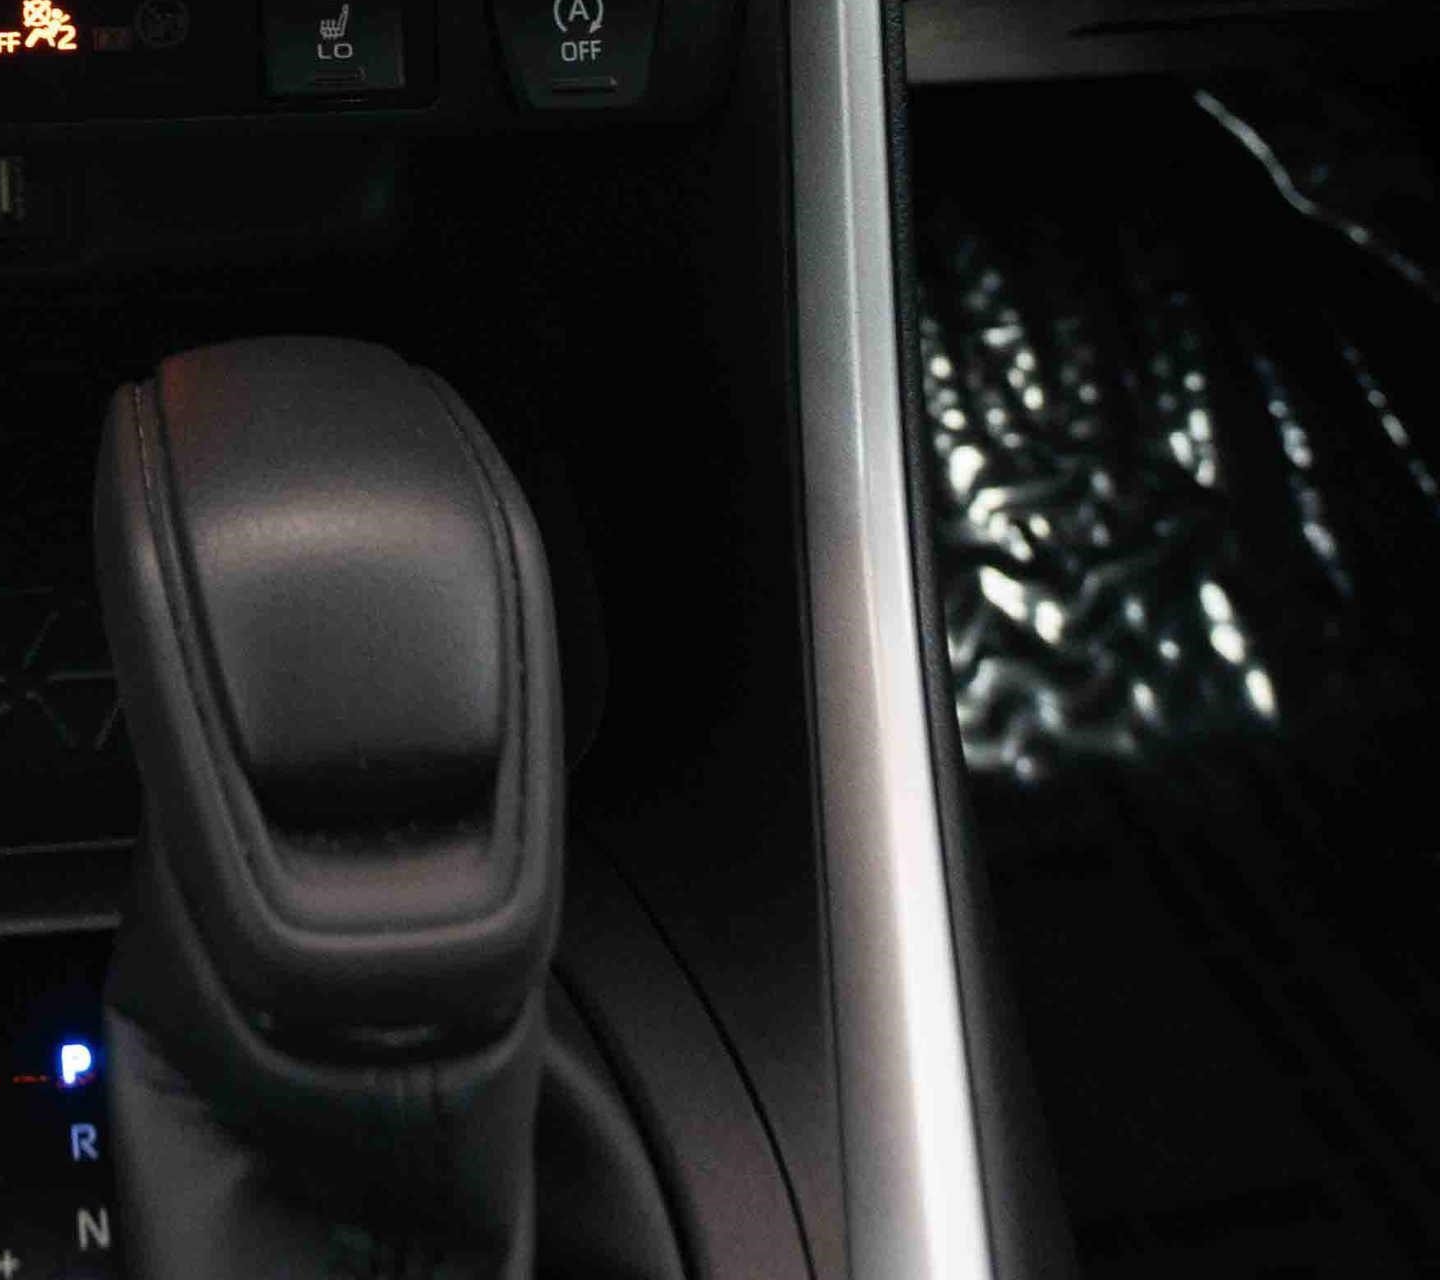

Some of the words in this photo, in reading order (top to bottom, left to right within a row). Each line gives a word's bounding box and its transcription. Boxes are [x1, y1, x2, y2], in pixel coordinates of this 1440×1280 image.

[317, 42, 354, 60] LO
[560, 40, 602, 62] OFF
[60, 1042, 94, 1086] P
[69, 1121, 101, 1162] R
[75, 1205, 112, 1251] N
